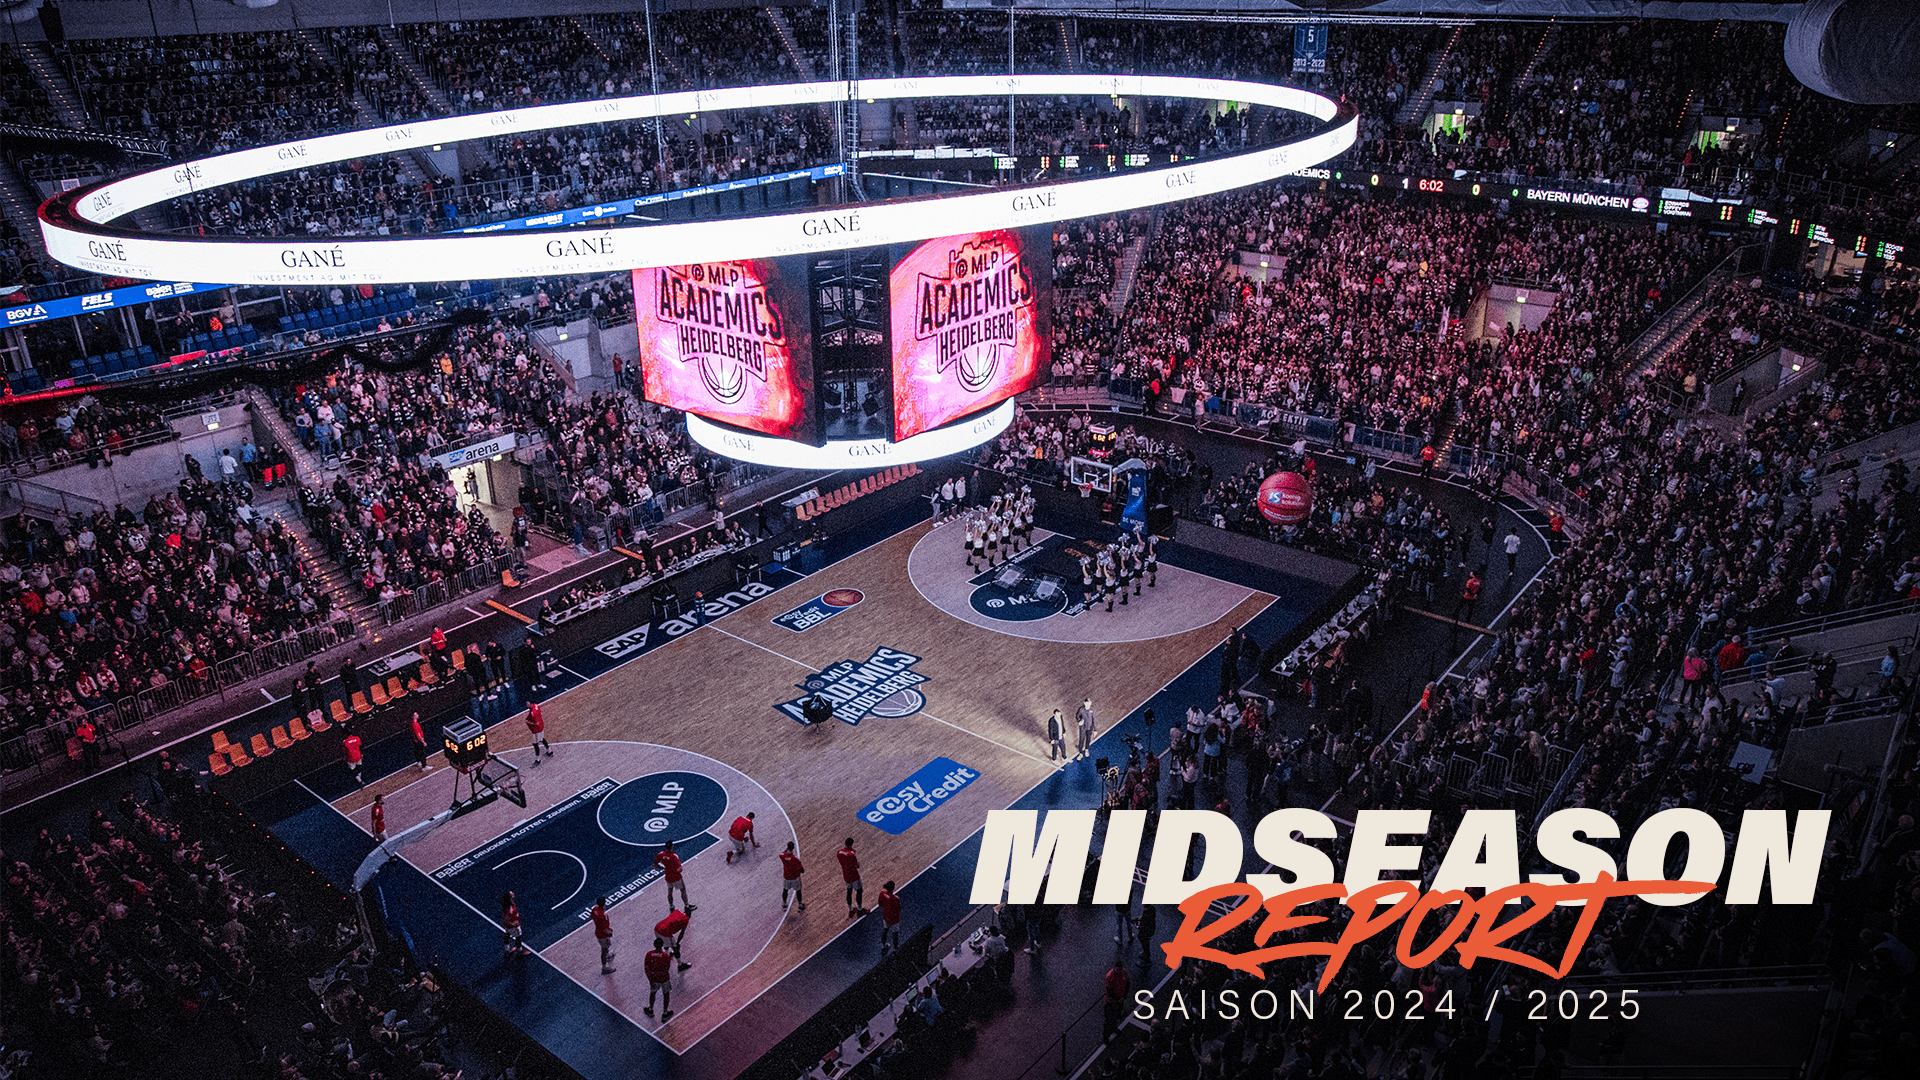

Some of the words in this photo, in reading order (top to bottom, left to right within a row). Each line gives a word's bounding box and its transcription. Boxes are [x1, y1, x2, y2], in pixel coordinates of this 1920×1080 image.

[1418, 178, 1444, 192] 6:02
[1527, 188, 1571, 203] BAYERN
[1572, 192, 1630, 209] MÜNCHEN
[802, 210, 861, 236] GANÉ
[88, 240, 127, 262] GANÉ
[280, 245, 346, 268] GANÉ
[546, 232, 614, 258] GANÉ
[971, 251, 998, 274] MLP
[708, 264, 738, 287] MLP
[660, 269, 782, 340] ACADEMICS
[920, 255, 1031, 334] ACADEMICS
[6, 307, 32, 320] BGV
[680, 325, 762, 373] HEIDELBERG
[940, 311, 1014, 365] HEIDELBERG
[1261, 409, 1308, 426] KOEKTIV
[466, 442, 499, 460] arena
[600, 631, 647, 656] SAP
[658, 580, 775, 636] arena
[793, 610, 832, 630] BBL
[821, 662, 854, 682] MLP
[832, 670, 925, 724] HEIDELBERG
[650, 780, 685, 815] MLP
[908, 768, 976, 812] Credit
